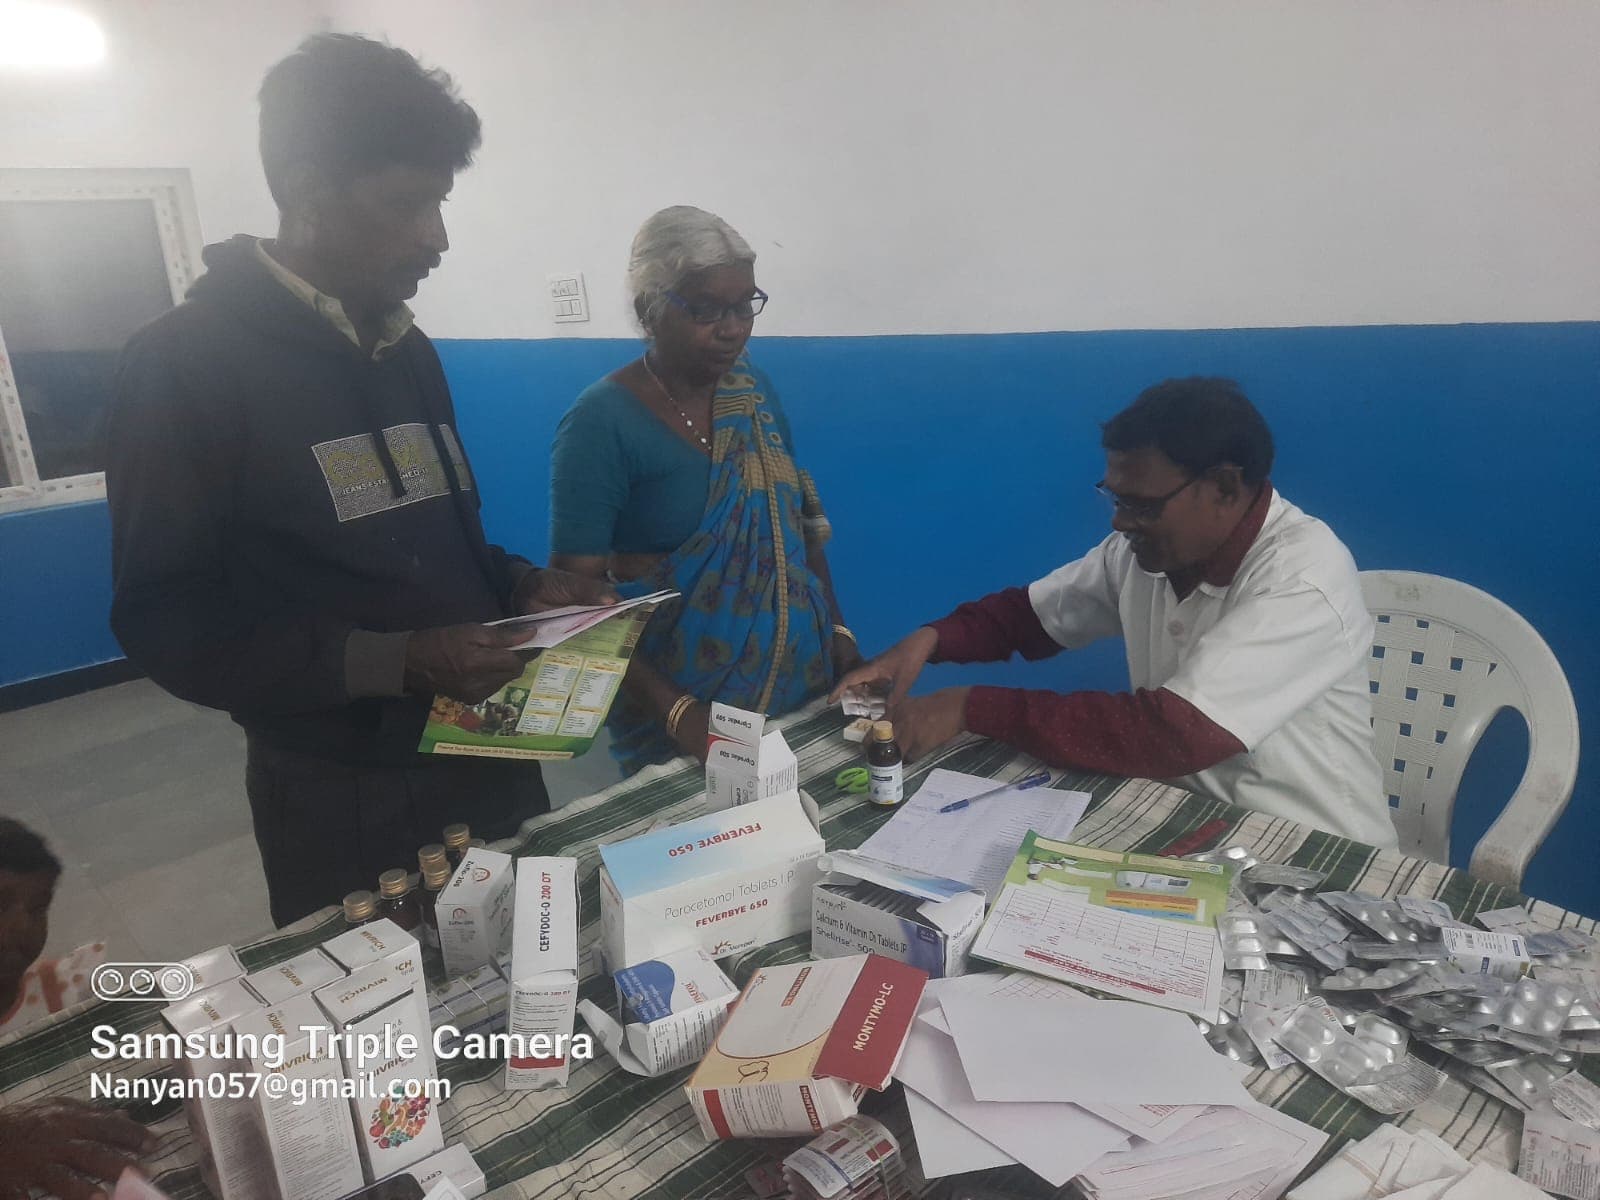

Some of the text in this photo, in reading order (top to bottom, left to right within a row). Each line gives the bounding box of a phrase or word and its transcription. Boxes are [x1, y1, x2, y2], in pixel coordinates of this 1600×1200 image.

[668, 822, 762, 857] FEVERBYE 650
[541, 871, 552, 884] DT
[738, 877, 778, 897] Tablets
[541, 885, 552, 900] 200
[695, 898, 769, 927] FEVERBYE 650
[815, 909, 839, 929] Calcium
[845, 920, 868, 941] Vitamin
[877, 933, 899, 952] Tablets
[852, 982, 894, 1051] MONTYMO-LC
